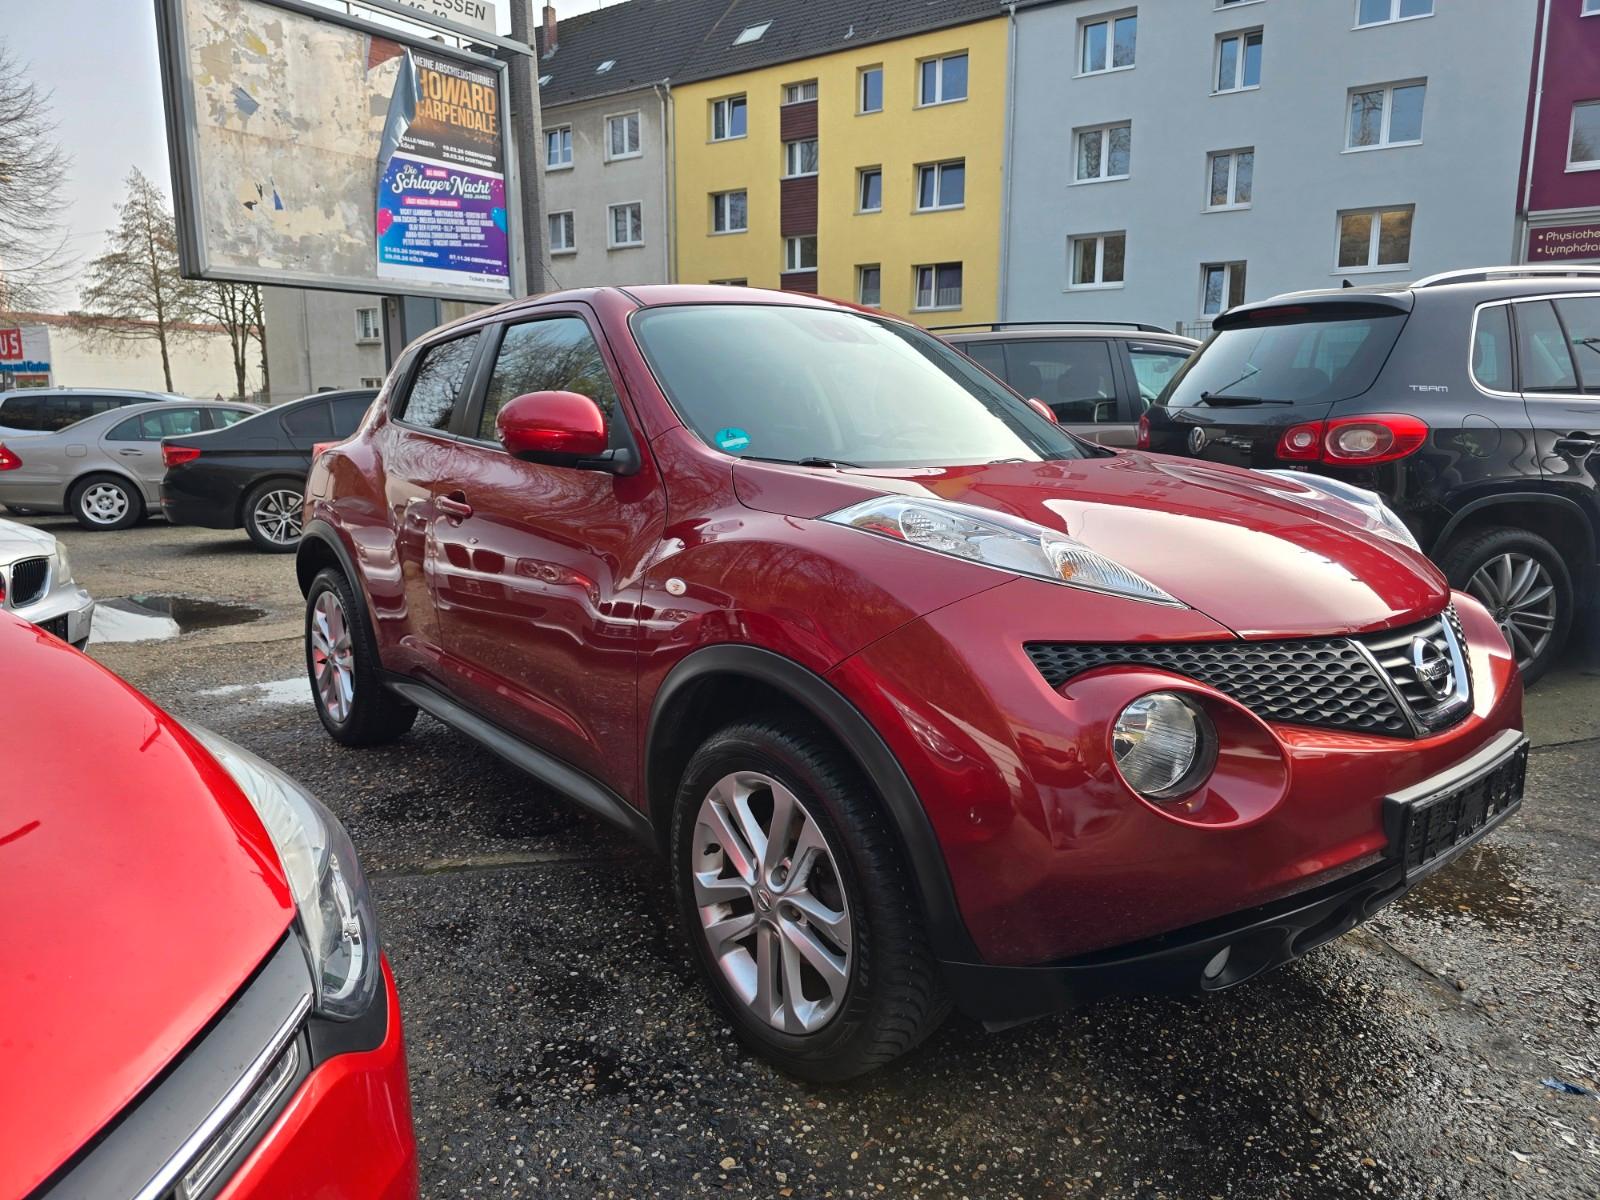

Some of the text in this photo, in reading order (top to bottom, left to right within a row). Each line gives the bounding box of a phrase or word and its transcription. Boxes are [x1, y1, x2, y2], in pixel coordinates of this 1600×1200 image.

[413, 55, 434, 69] MEINE
[404, 164, 417, 175] Die
[1409, 384, 1449, 393] TEAM
